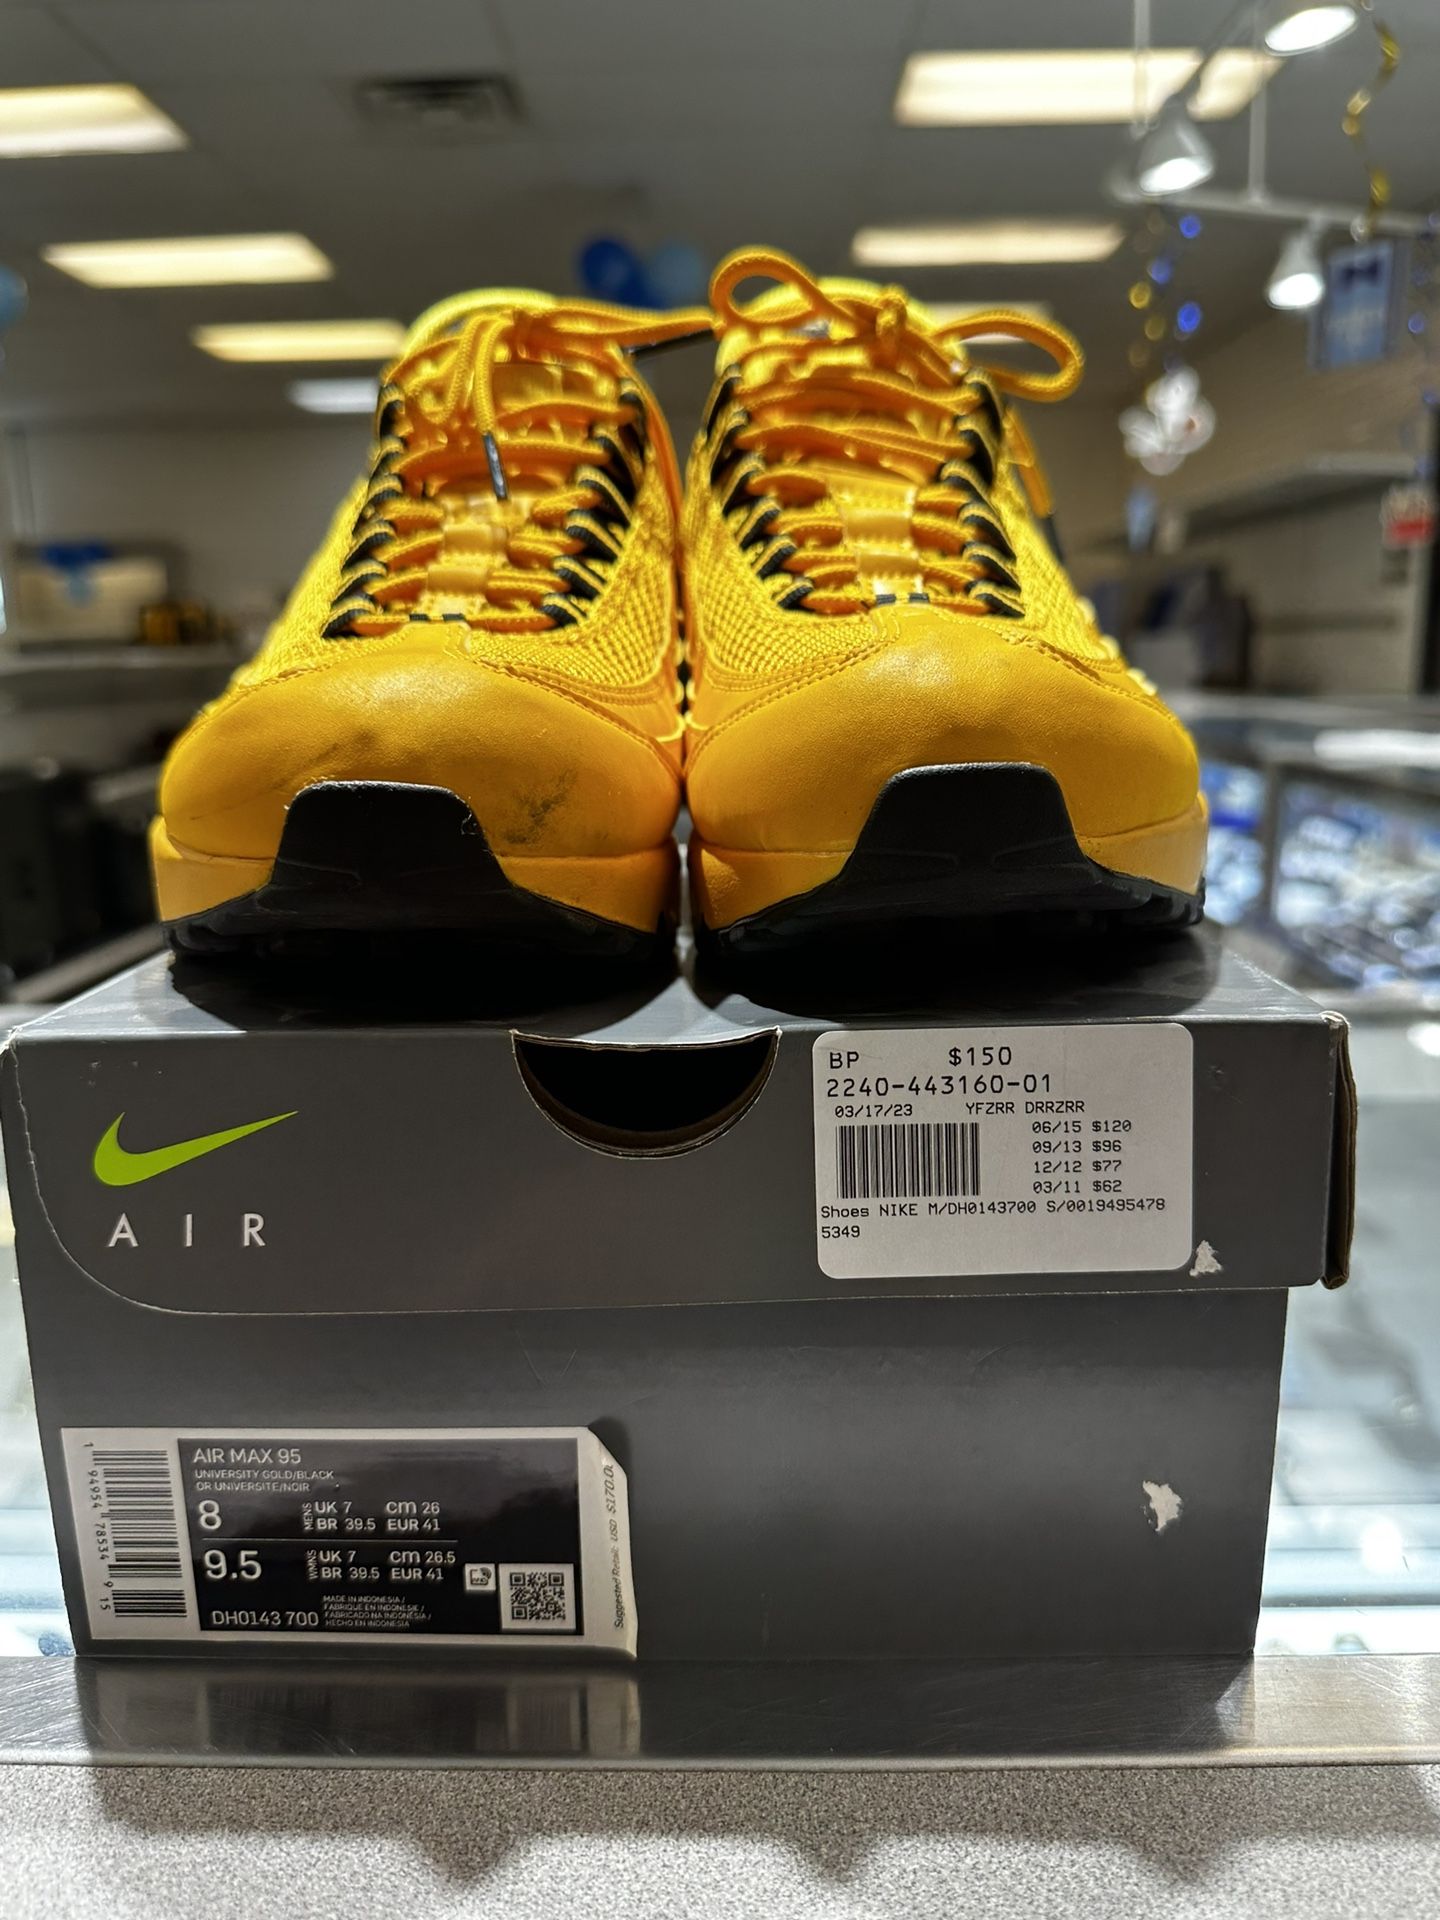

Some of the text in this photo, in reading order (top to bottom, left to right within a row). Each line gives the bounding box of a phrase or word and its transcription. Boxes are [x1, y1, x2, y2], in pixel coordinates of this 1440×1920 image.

[829, 1047, 1012, 1069] BP $150
[827, 1074, 1050, 1098] 2240-443160-01
[835, 1100, 1085, 1118] 03/17/23 YFZRR DRRZRR
[1032, 1119, 1132, 1133] 06/15 $120
[1032, 1139, 1122, 1153] 09/13 $96
[1034, 1160, 1122, 1173] 12/12 $77
[1033, 1180, 1122, 1194] 03/11 $62
[821, 1198, 1166, 1219] Shoes NIKE M/DH0143700 S/0019495478
[107, 1212, 266, 1247] AIR
[821, 1225, 861, 1239] 5349
[193, 1448, 302, 1464] AIR MAX 95
[194, 1469, 334, 1480] UNIVERSITY GOLD/BLACK
[88, 1470, 103, 1509] 94954
[196, 1482, 310, 1492] OR UNIVERSITE/NOIR
[314, 1501, 352, 1514] UK 7
[421, 1502, 441, 1514] 26
[199, 1500, 222, 1530] 8
[302, 1502, 314, 1530] MENS
[316, 1518, 376, 1530] BR 39.5
[387, 1518, 441, 1531] EUR 41
[609, 1519, 618, 1541] USD
[95, 1523, 109, 1561] 78534
[319, 1550, 357, 1562] UK 7
[425, 1551, 456, 1563] 26.5
[204, 1549, 262, 1580] 9.5
[307, 1549, 319, 1580] WMNS
[321, 1567, 380, 1579] BR 39.5
[391, 1568, 444, 1579] EUR 41
[99, 1597, 111, 1611] 15
[612, 1578, 625, 1629] Suggested
[212, 1610, 319, 1626] DH0143 700
